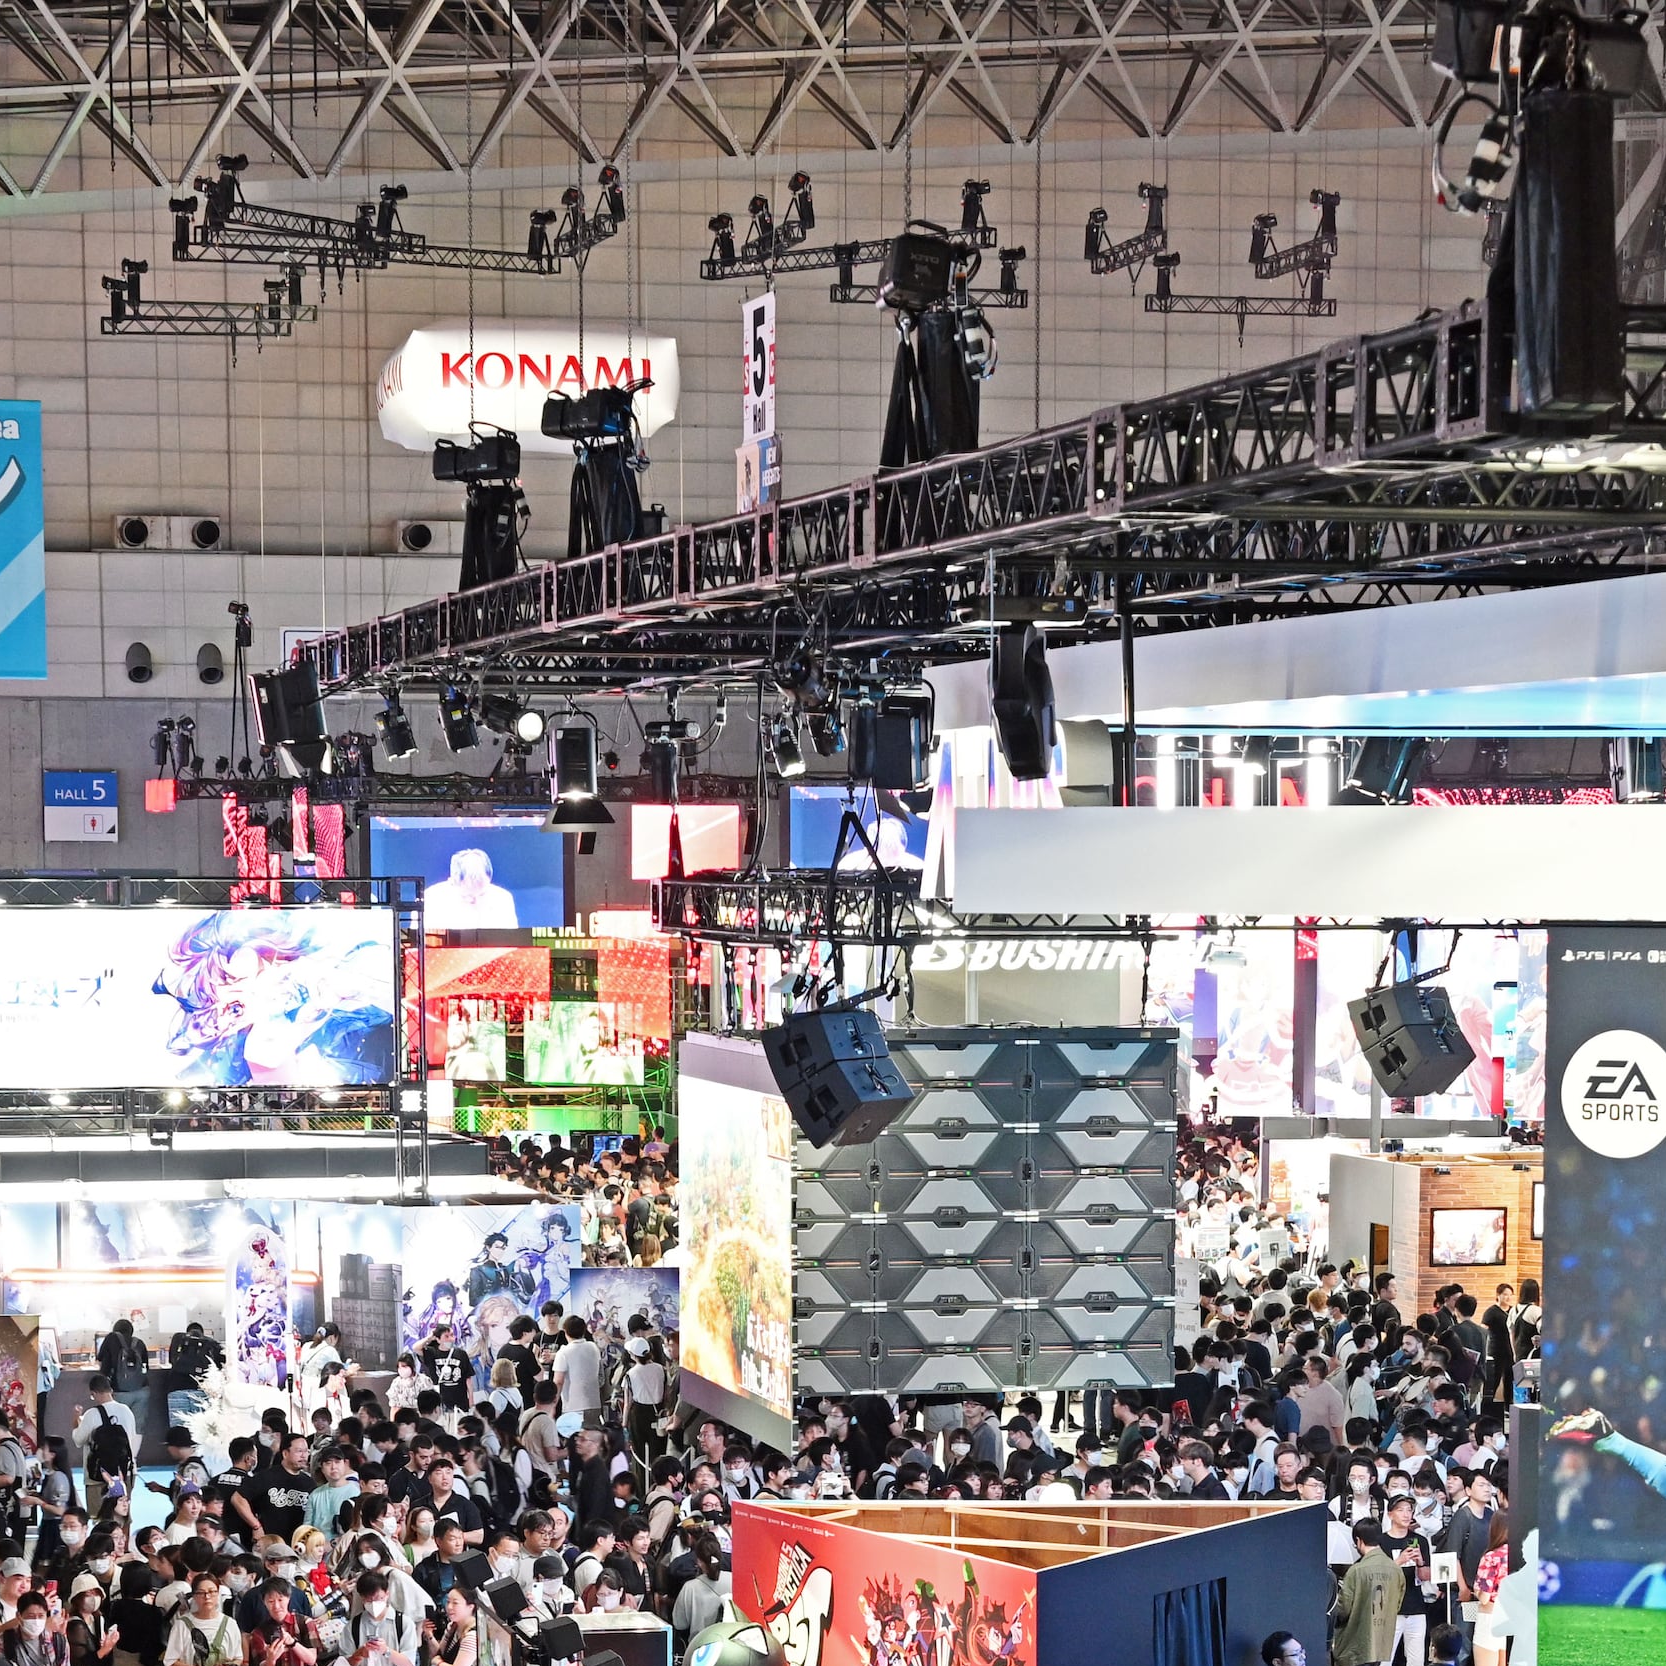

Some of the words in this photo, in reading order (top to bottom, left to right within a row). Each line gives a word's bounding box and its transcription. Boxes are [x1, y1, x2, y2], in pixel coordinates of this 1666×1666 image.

[753, 306, 765, 397] 5
[441, 353, 651, 394] KONAMI
[752, 401, 765, 434] Hall
[54, 790, 88, 802] HALL
[92, 780, 106, 801] 5
[1577, 951, 1605, 961] PS5
[1612, 951, 1642, 961] PS4
[1583, 1060, 1657, 1100] EA
[1582, 1103, 1659, 1121] SPORTS
